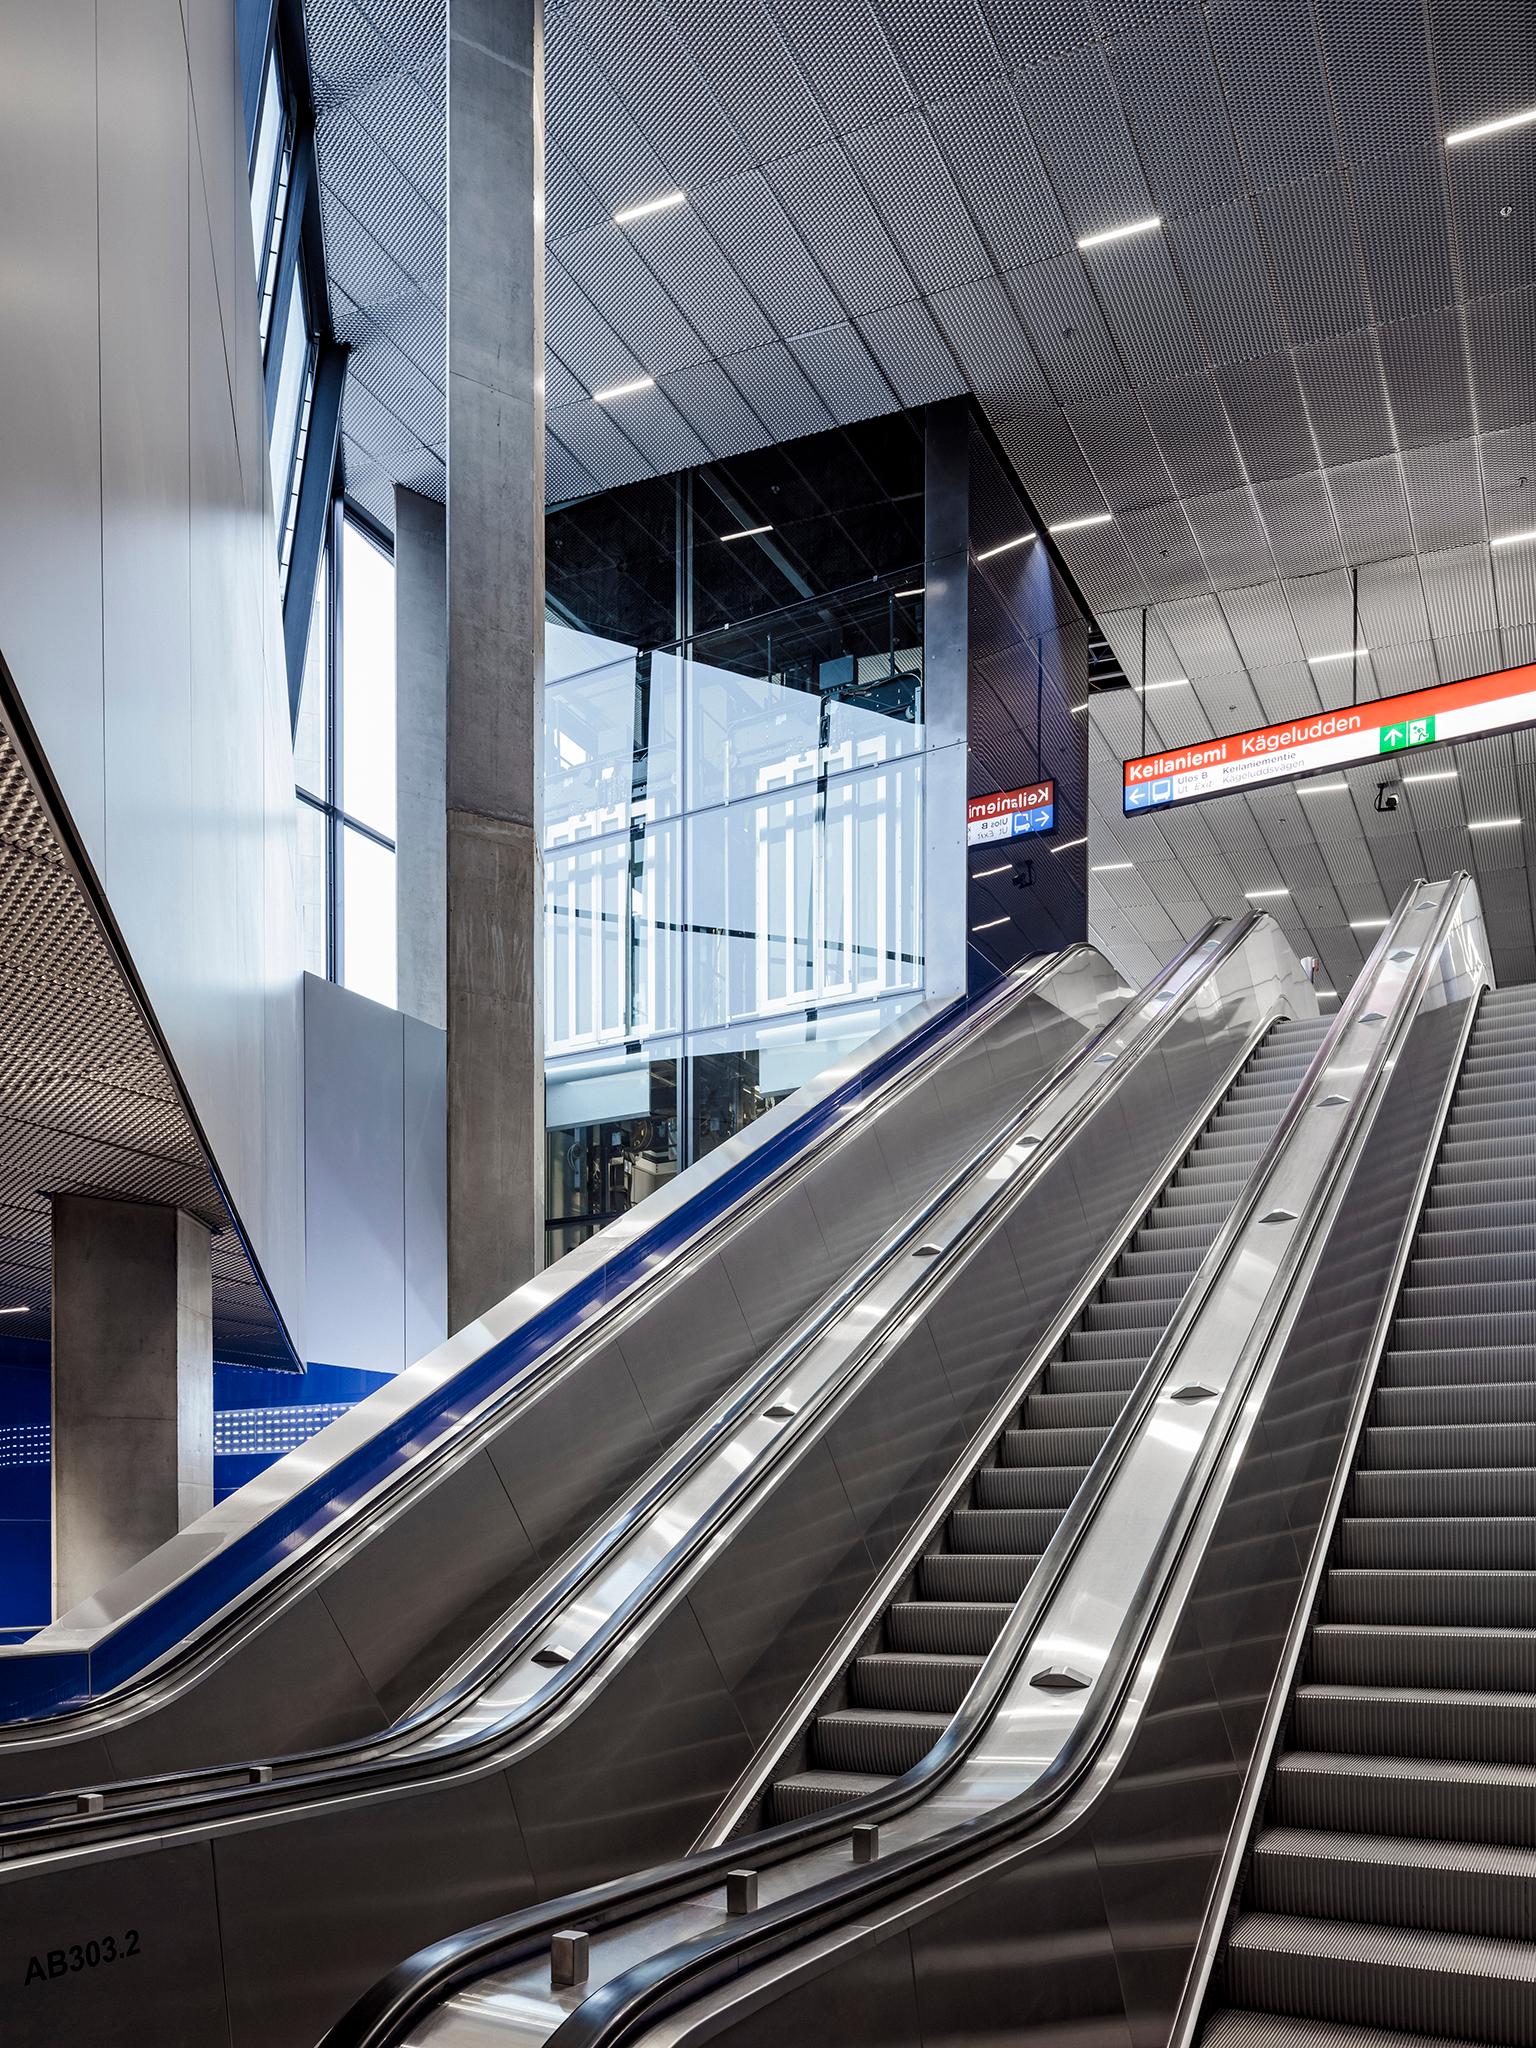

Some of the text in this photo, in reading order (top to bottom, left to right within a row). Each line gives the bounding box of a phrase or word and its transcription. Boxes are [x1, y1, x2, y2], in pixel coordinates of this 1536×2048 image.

[1130, 714, 1361, 781] Keilaniemi Kägeludden
[1222, 752, 1296, 775] Keilaniementie
[1177, 771, 1208, 785] Ulos B
[1194, 781, 1214, 791] Exit
[24, 1929, 141, 1987] AB303.2
